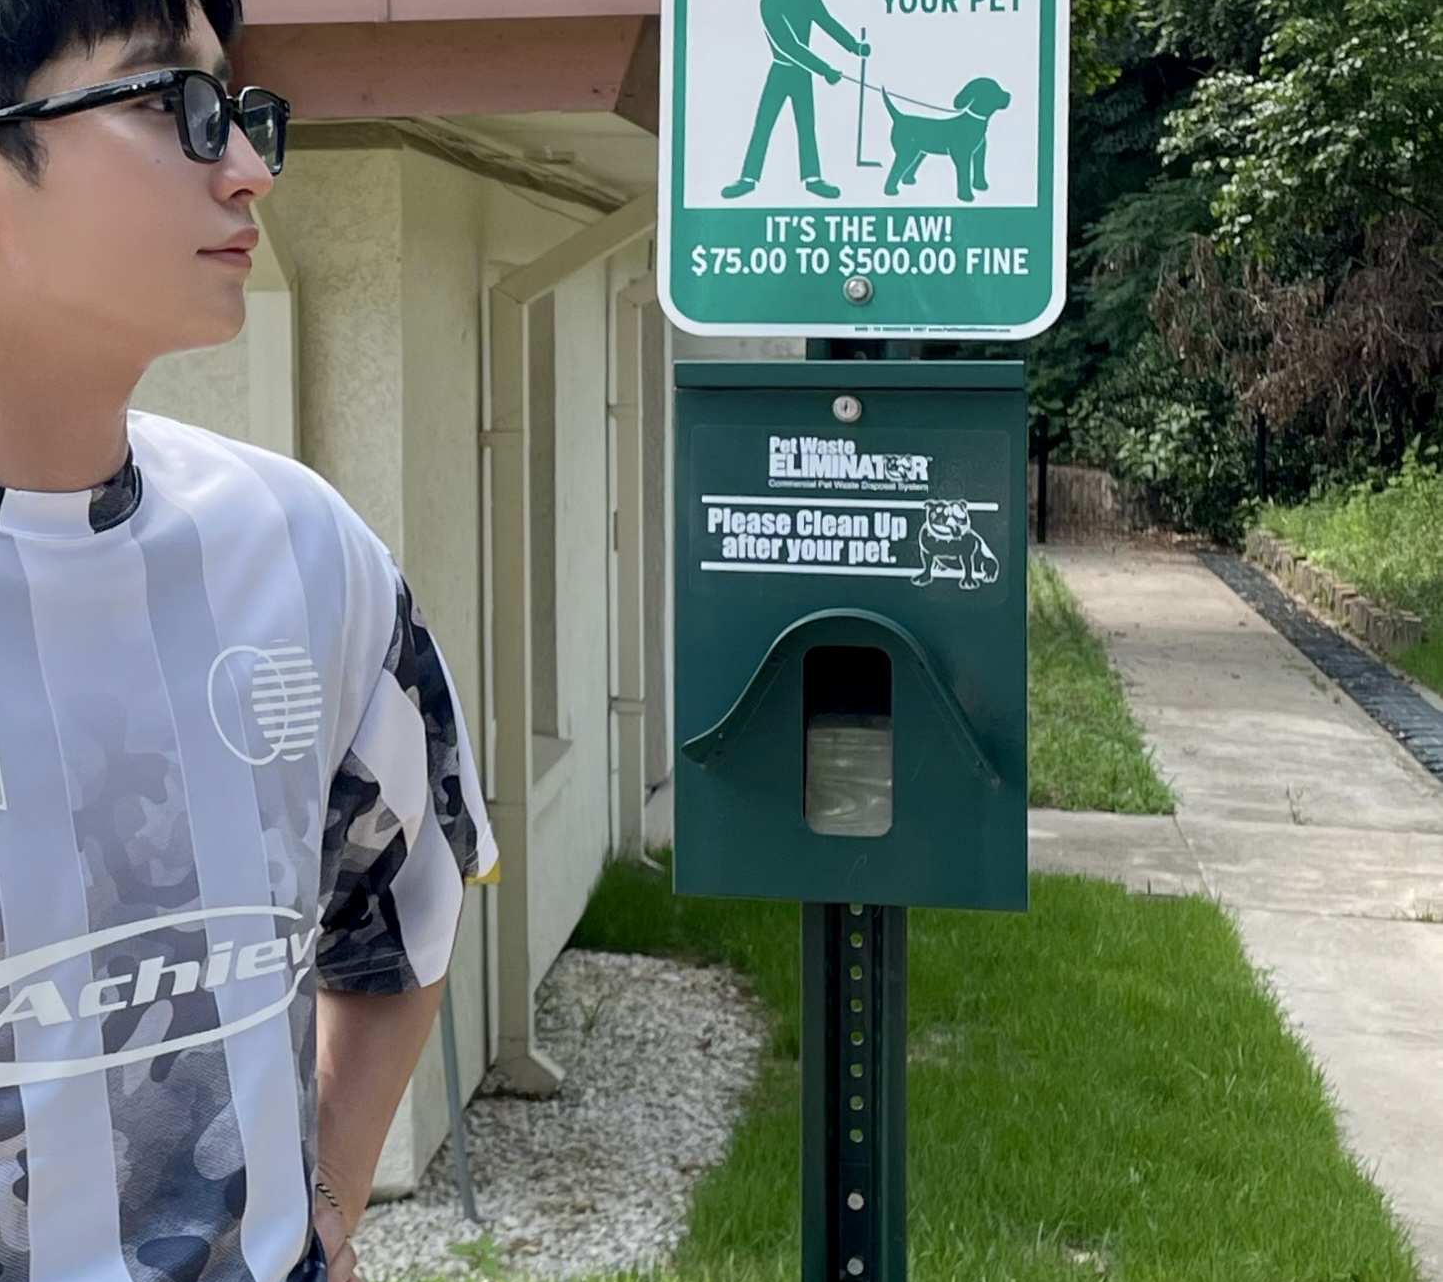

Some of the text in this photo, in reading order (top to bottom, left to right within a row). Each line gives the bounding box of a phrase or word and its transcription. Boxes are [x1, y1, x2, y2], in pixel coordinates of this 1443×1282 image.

[765, 215, 953, 243] IT'S THE LAW!
[690, 245, 1029, 277] $75.00 TO $500.00 FINE
[769, 435, 856, 455] Pet Waste
[707, 507, 908, 542] Please Clean Up
[721, 533, 898, 565] after your pet.
